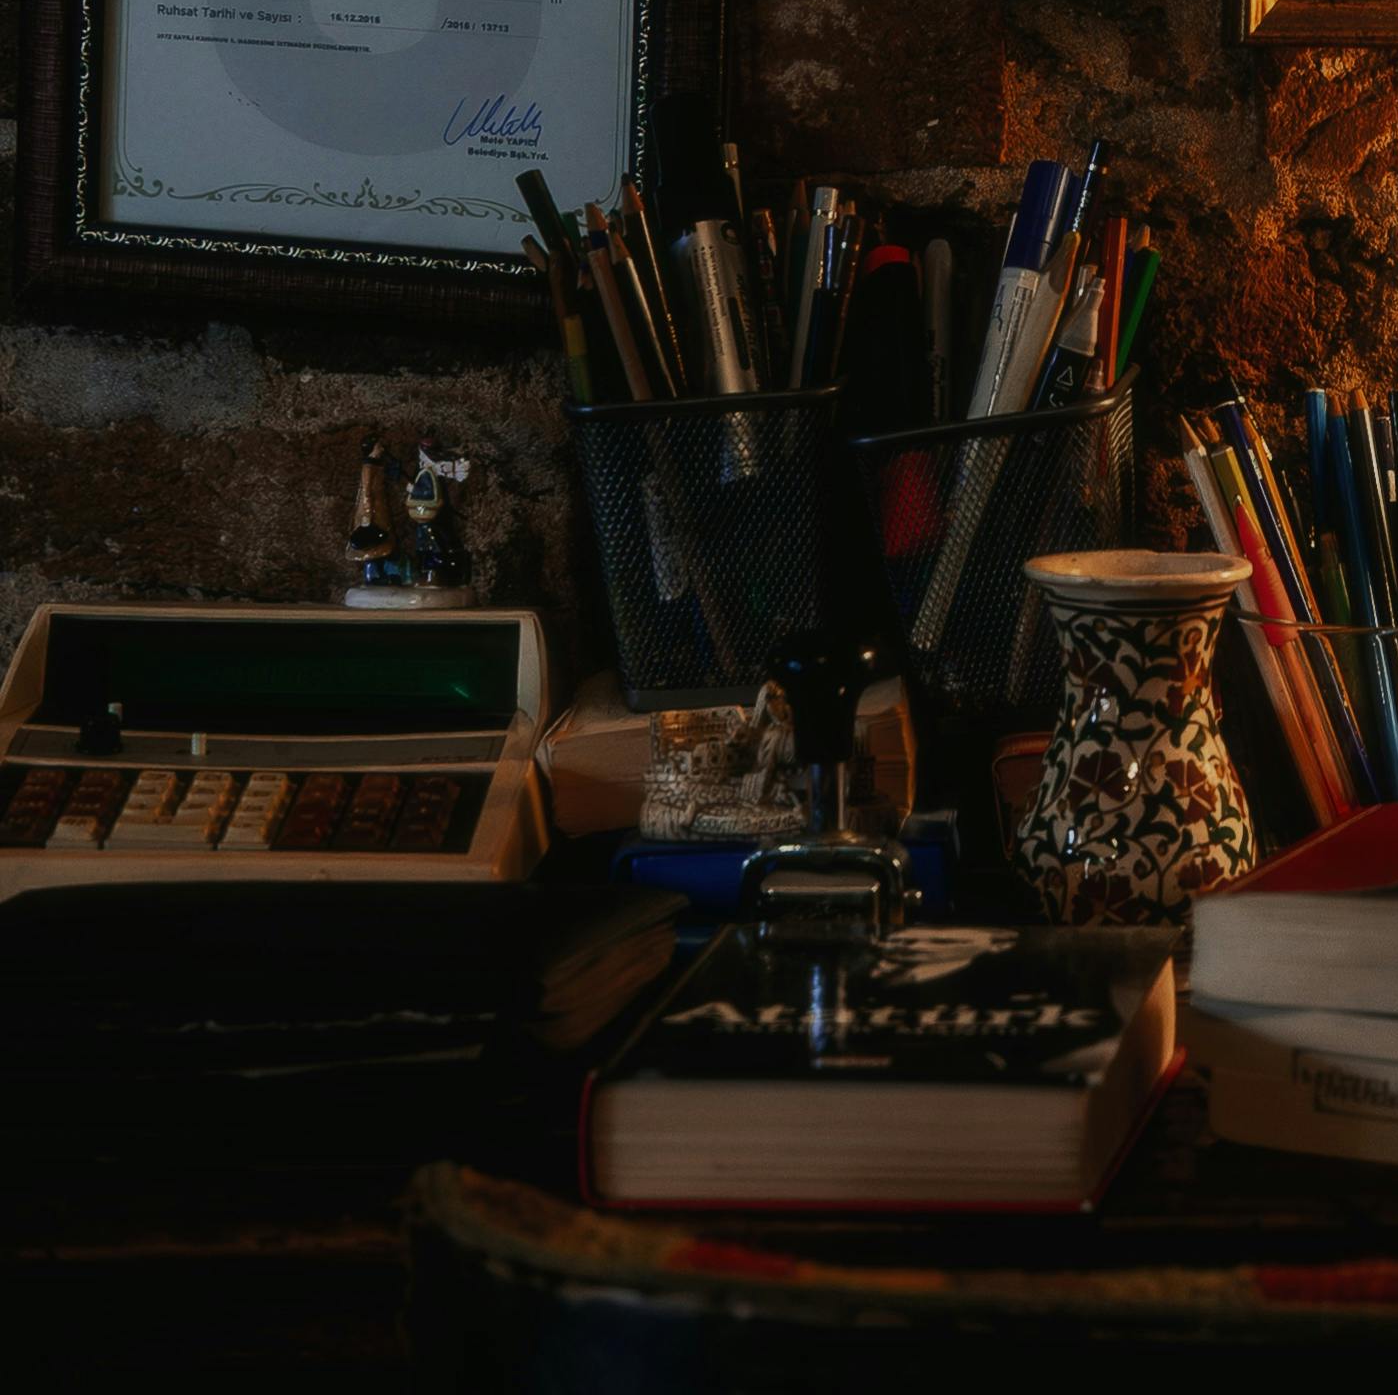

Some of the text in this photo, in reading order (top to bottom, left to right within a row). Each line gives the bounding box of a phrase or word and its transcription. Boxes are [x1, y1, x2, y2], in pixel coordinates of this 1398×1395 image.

[157, 4, 199, 18] Ruhsat
[201, 6, 236, 20] Tarihi
[239, 12, 254, 21] ve
[257, 12, 292, 25] Sayısı
